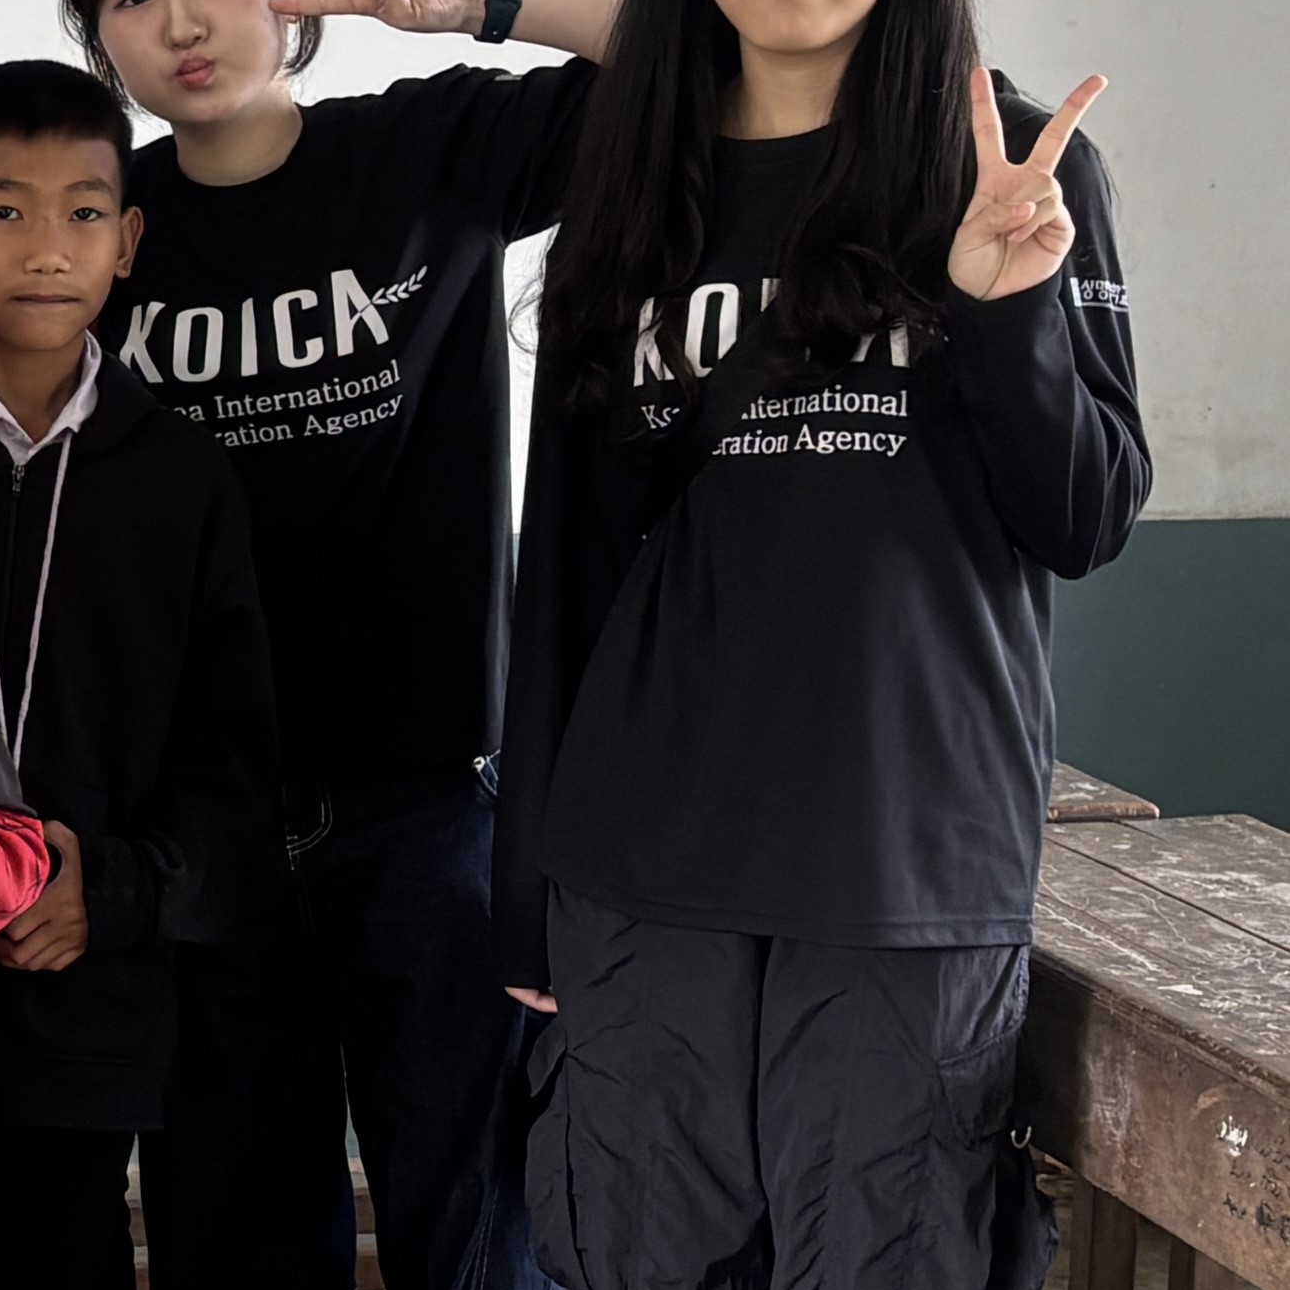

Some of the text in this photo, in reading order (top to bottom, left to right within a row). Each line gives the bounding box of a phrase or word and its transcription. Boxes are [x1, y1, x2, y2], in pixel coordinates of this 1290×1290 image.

[120, 269, 389, 384] KOICA
[213, 358, 401, 419] International
[741, 384, 908, 419] ternational
[303, 394, 404, 436] Agency
[712, 424, 907, 457] ration Agency
